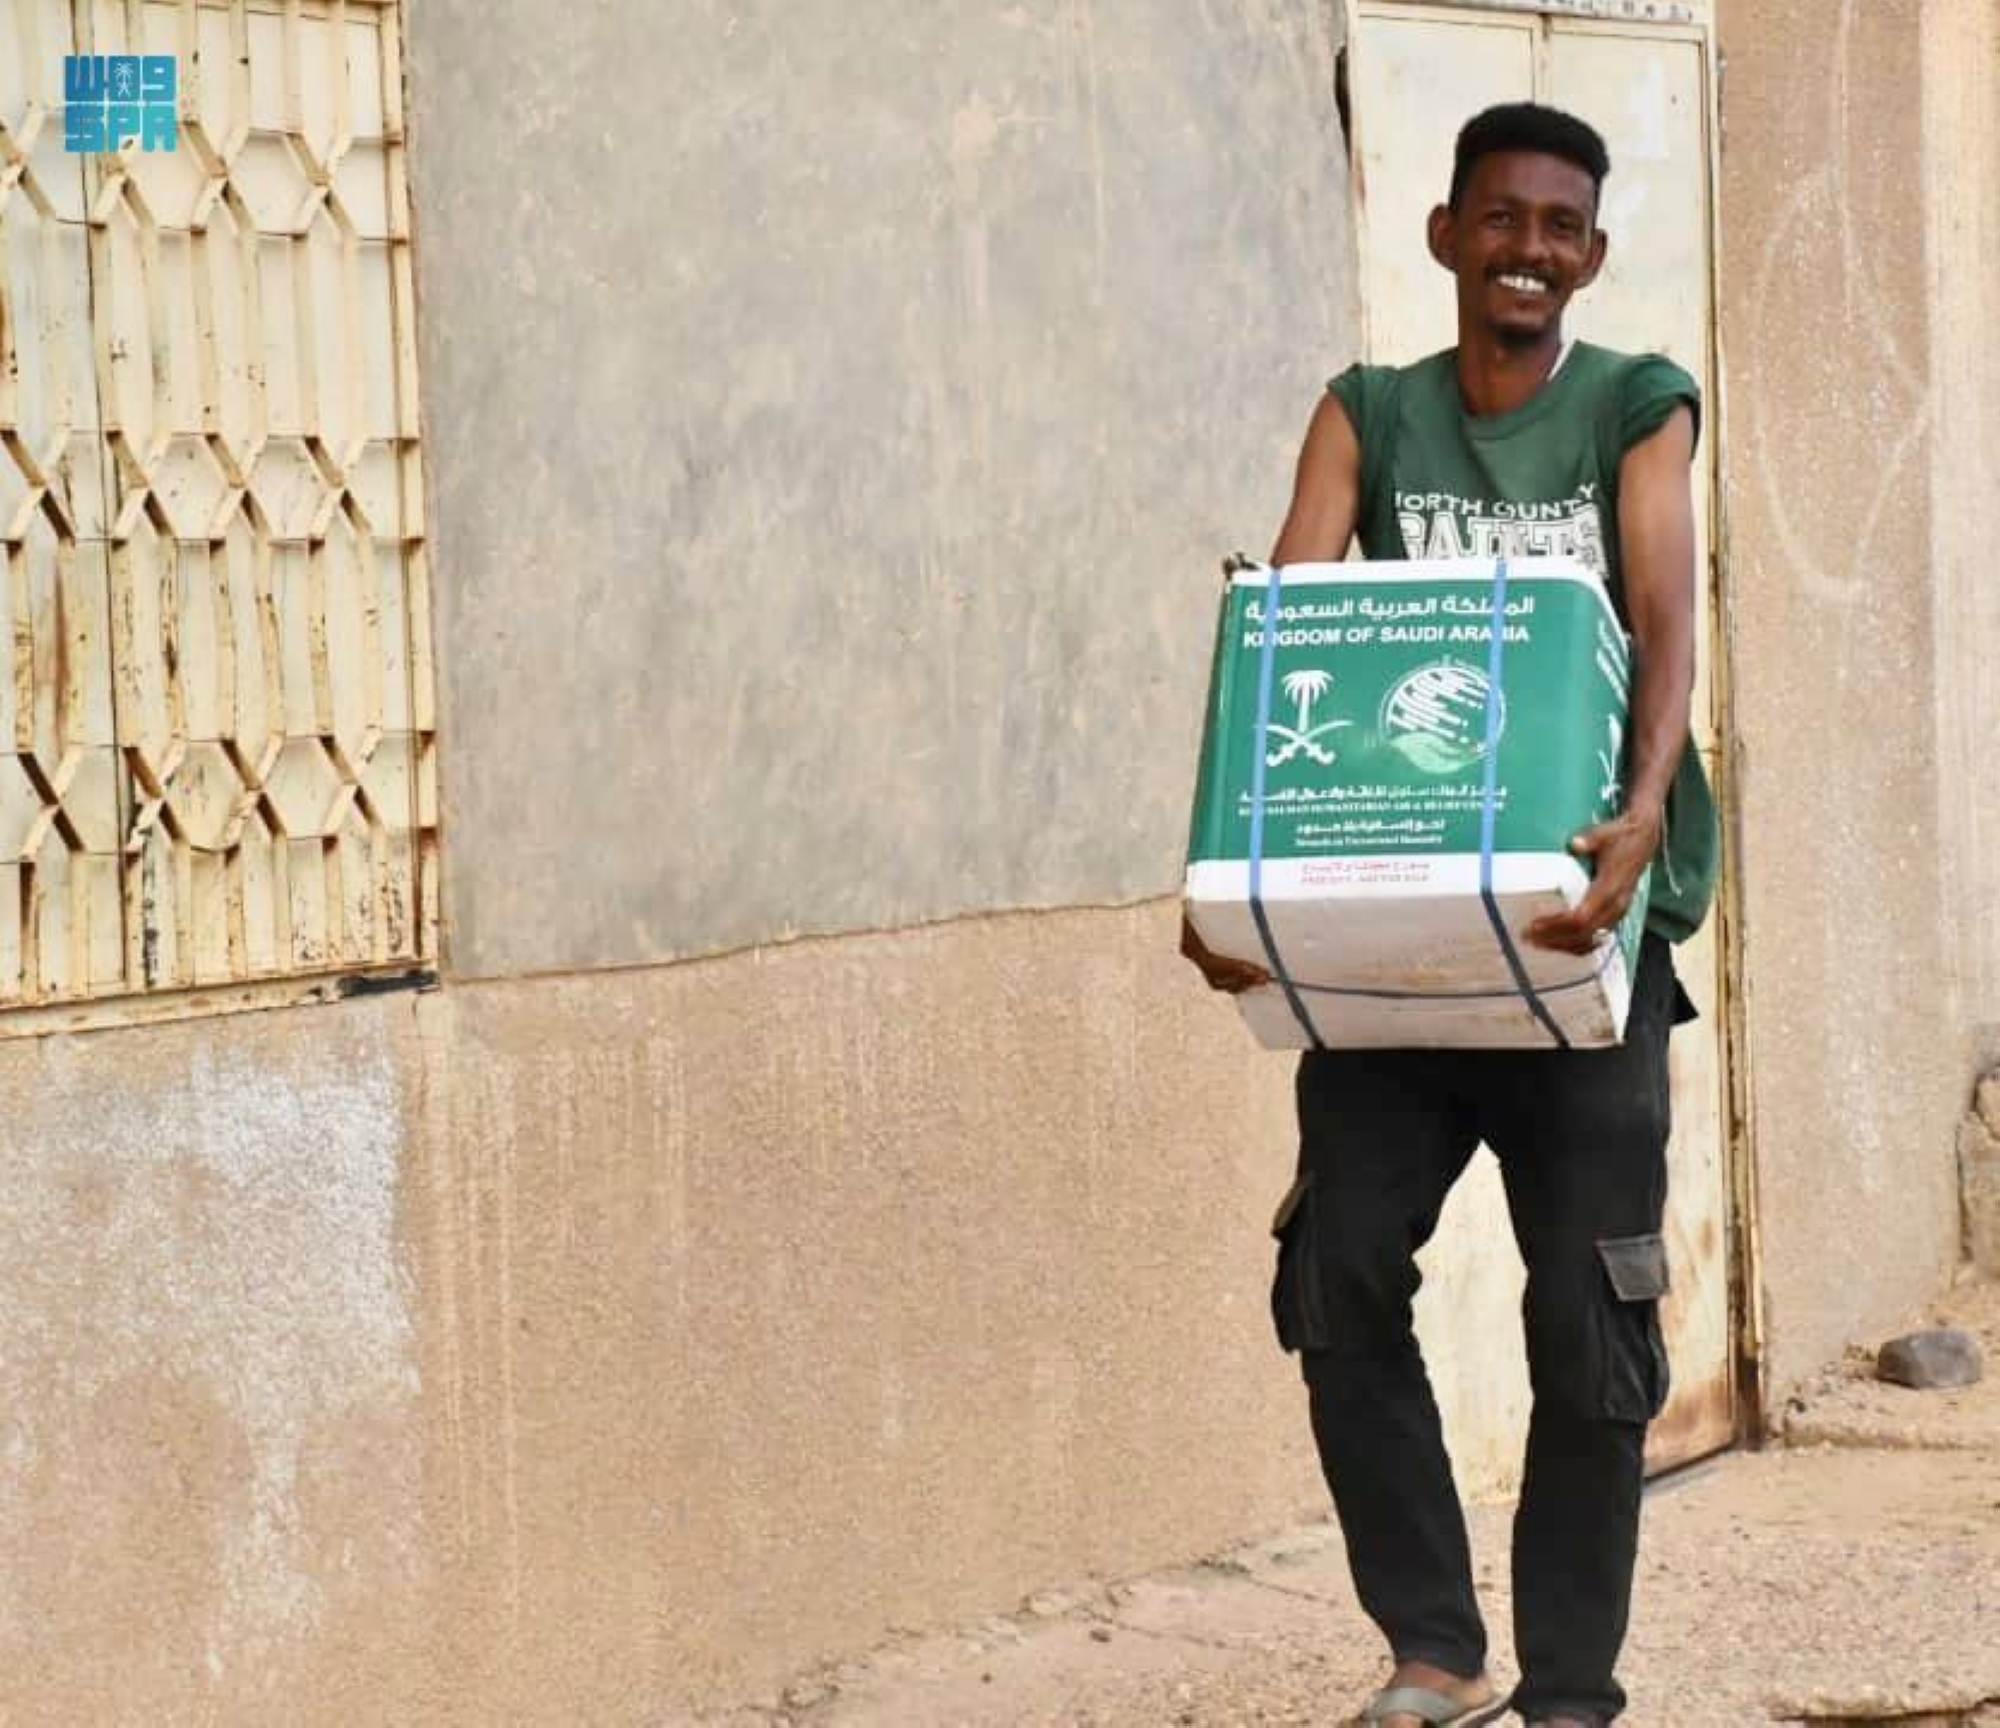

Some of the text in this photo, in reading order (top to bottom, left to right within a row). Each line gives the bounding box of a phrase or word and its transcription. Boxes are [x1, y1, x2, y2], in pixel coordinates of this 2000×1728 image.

[1359, 597, 1437, 620] العربية
[1346, 626, 1375, 644] OF
[1380, 626, 1444, 643] SAUDI
